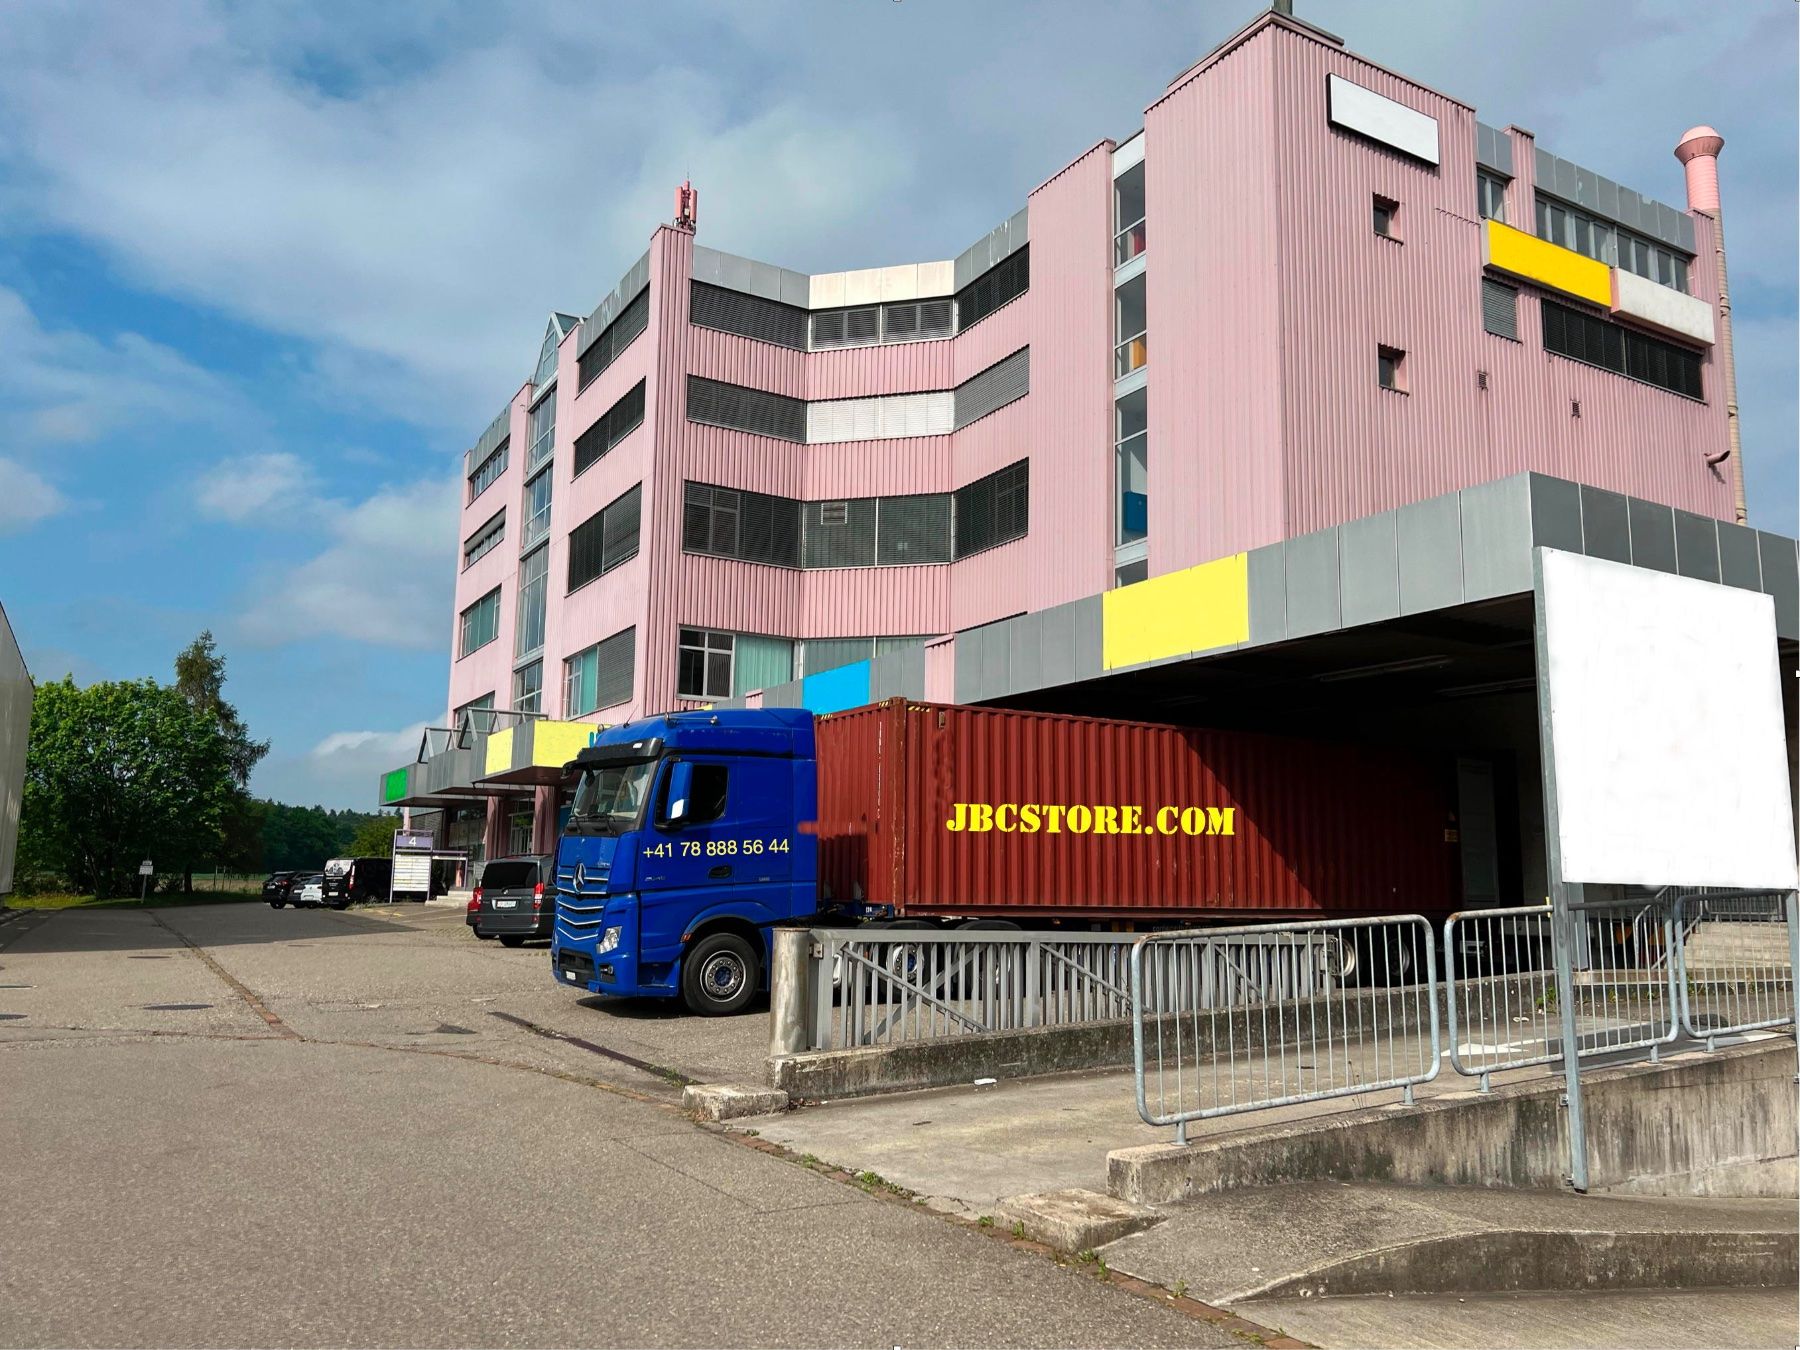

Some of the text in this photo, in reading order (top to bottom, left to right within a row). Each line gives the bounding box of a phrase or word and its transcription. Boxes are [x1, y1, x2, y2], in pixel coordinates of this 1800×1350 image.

[946, 803, 1236, 836] JBCSTORE.COM
[408, 837, 417, 847] 4
[642, 838, 790, 858] +41 78 888 56 44
